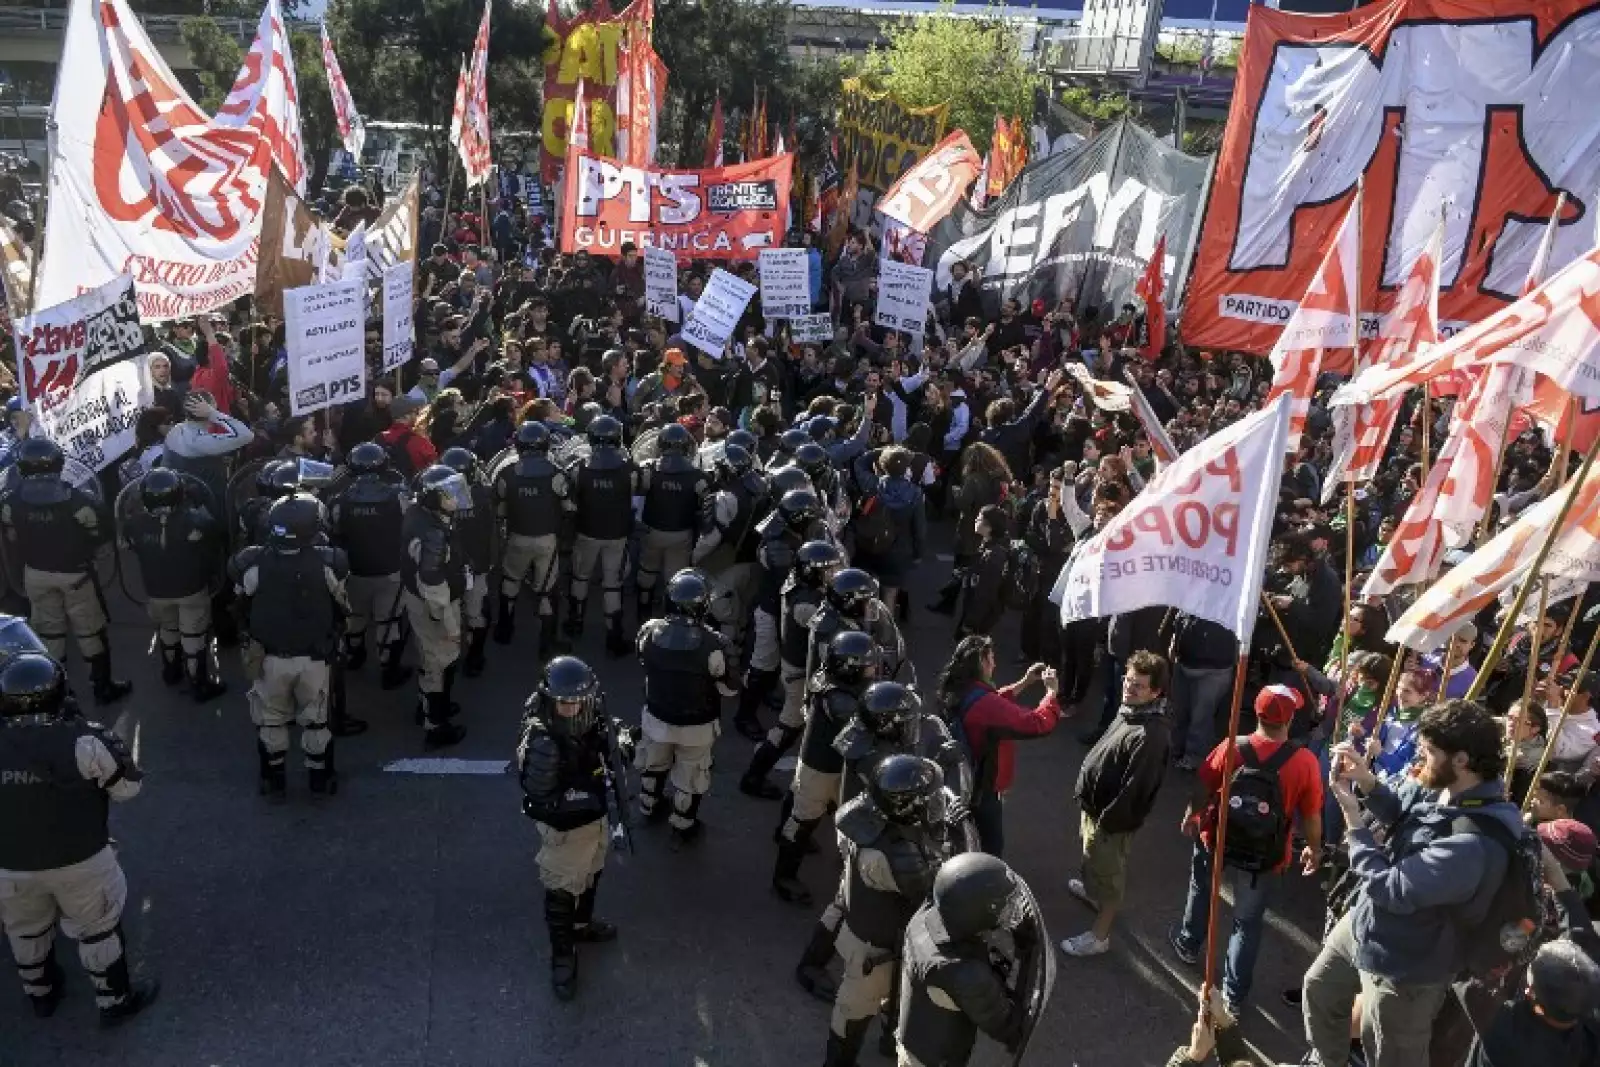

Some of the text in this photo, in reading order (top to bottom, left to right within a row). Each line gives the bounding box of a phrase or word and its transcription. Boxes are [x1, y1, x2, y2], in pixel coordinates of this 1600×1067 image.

[577, 155, 700, 224] PTS
[575, 226, 732, 250] GUERNICA
[1225, 298, 1291, 321] PARTIDO
[329, 375, 360, 399] PTS
